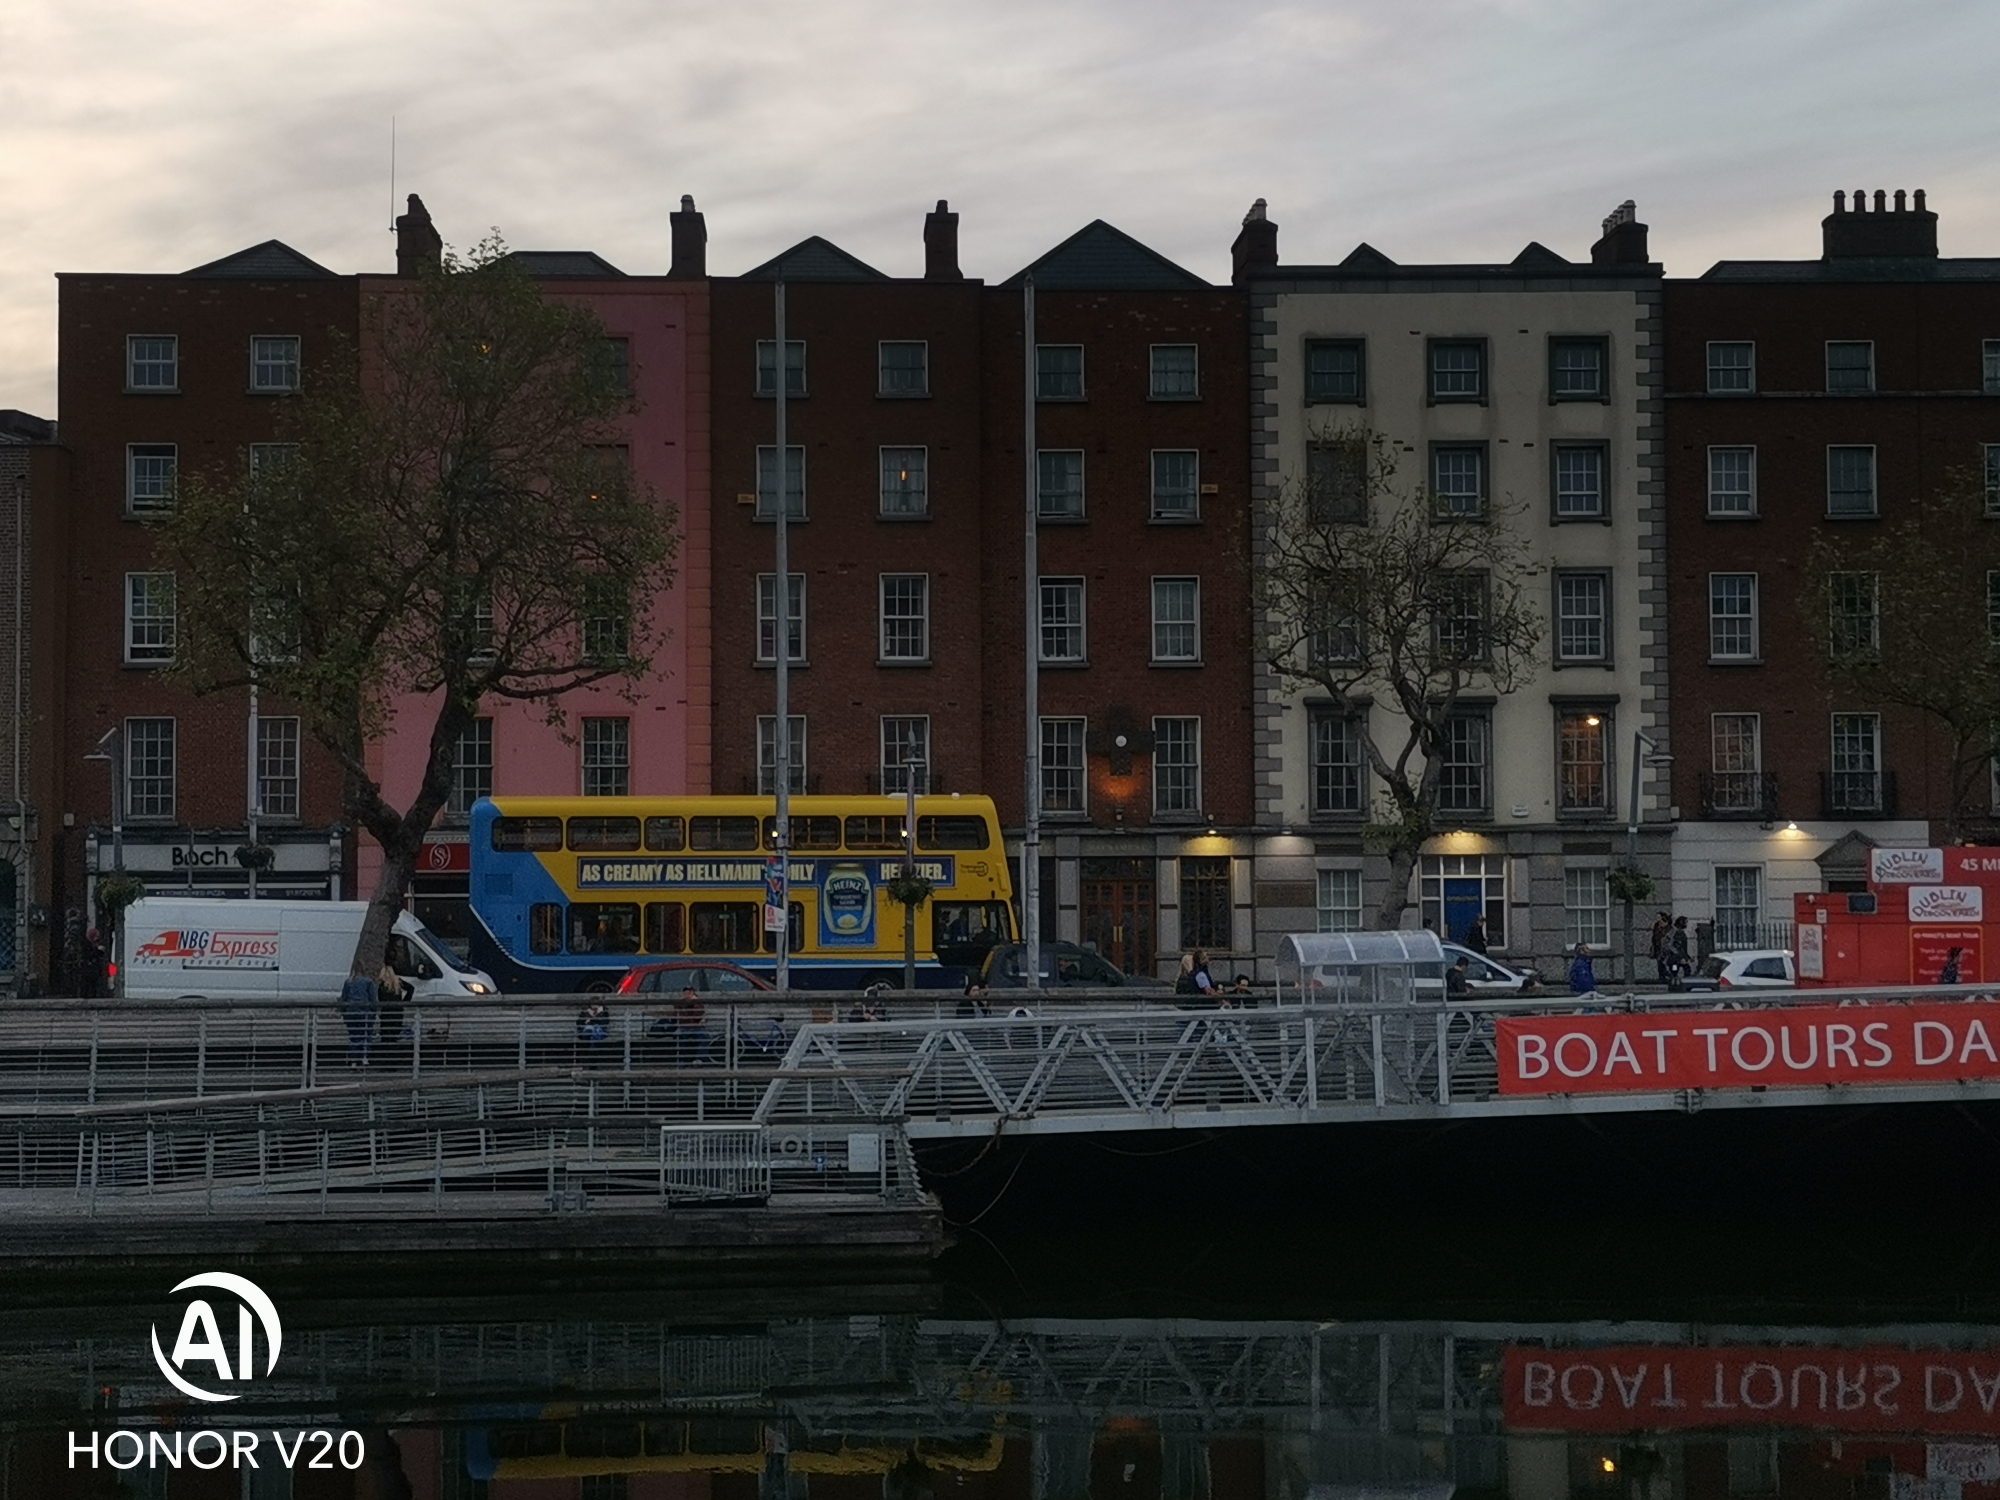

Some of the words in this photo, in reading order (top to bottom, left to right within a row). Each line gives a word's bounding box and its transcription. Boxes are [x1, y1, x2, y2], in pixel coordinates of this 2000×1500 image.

[172, 846, 228, 866] Bach
[1875, 851, 1929, 878] DUBLIN
[1959, 858, 1979, 871] 45
[582, 864, 601, 882] AS
[603, 864, 663, 882] CREAMY
[665, 864, 684, 882] AS
[787, 864, 815, 881] NLY
[833, 879, 862, 891] HEINZ
[1912, 889, 1967, 917] DUBLIN
[178, 930, 210, 949] NBG
[210, 931, 279, 960] Express
[1516, 1028, 1678, 1080] BOAT
[1692, 1022, 1893, 1073] TOURS
[1912, 1019, 2000, 1066] DA
